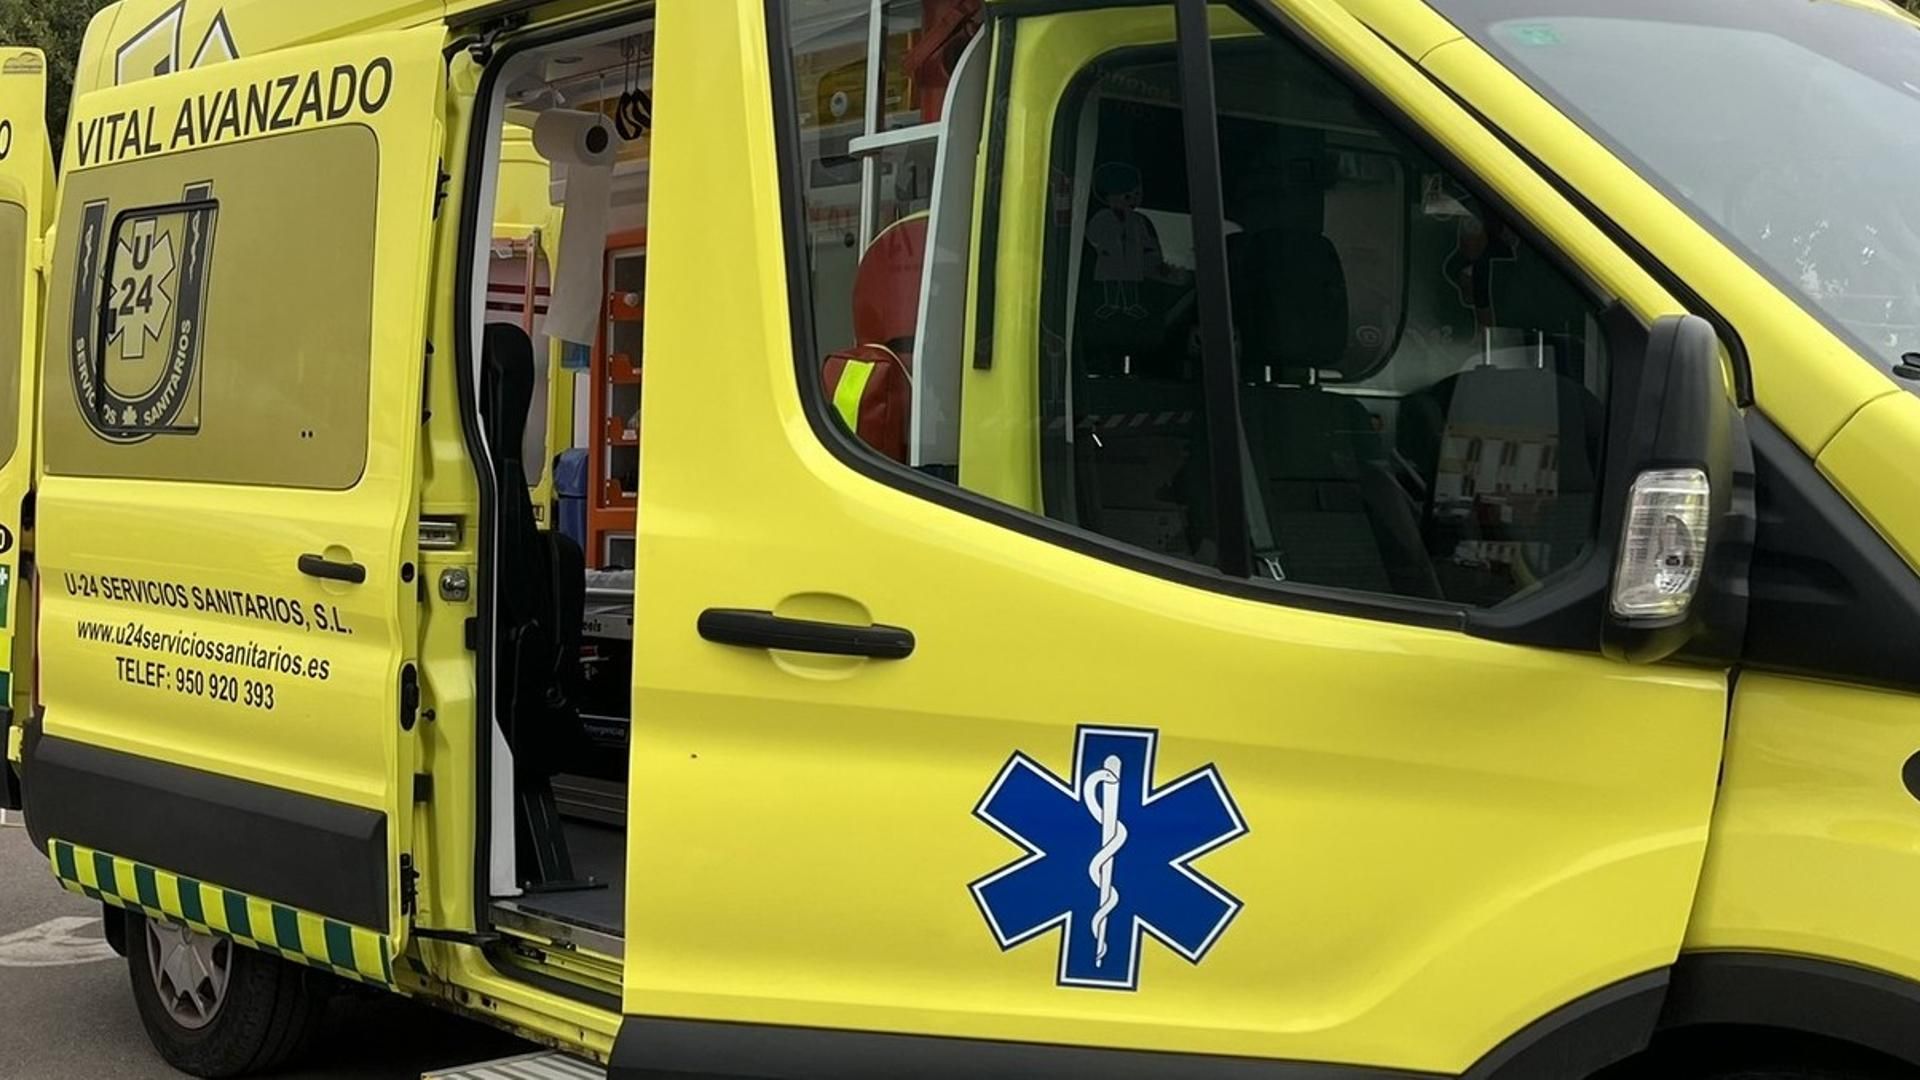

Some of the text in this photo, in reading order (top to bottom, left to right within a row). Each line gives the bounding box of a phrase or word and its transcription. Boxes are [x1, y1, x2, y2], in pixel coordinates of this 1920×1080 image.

[78, 57, 393, 166] VITAL AVANZADO
[132, 234, 152, 271] U
[119, 275, 153, 316] 24
[76, 319, 191, 426] SERVICOS SANITARIOS
[64, 572, 353, 634] U-24 SERVICIOS SANITARIOS, S.L.
[77, 620, 330, 680] www.u24serviciossanitarios.es
[115, 656, 274, 710] TELEF: 950 920 393
